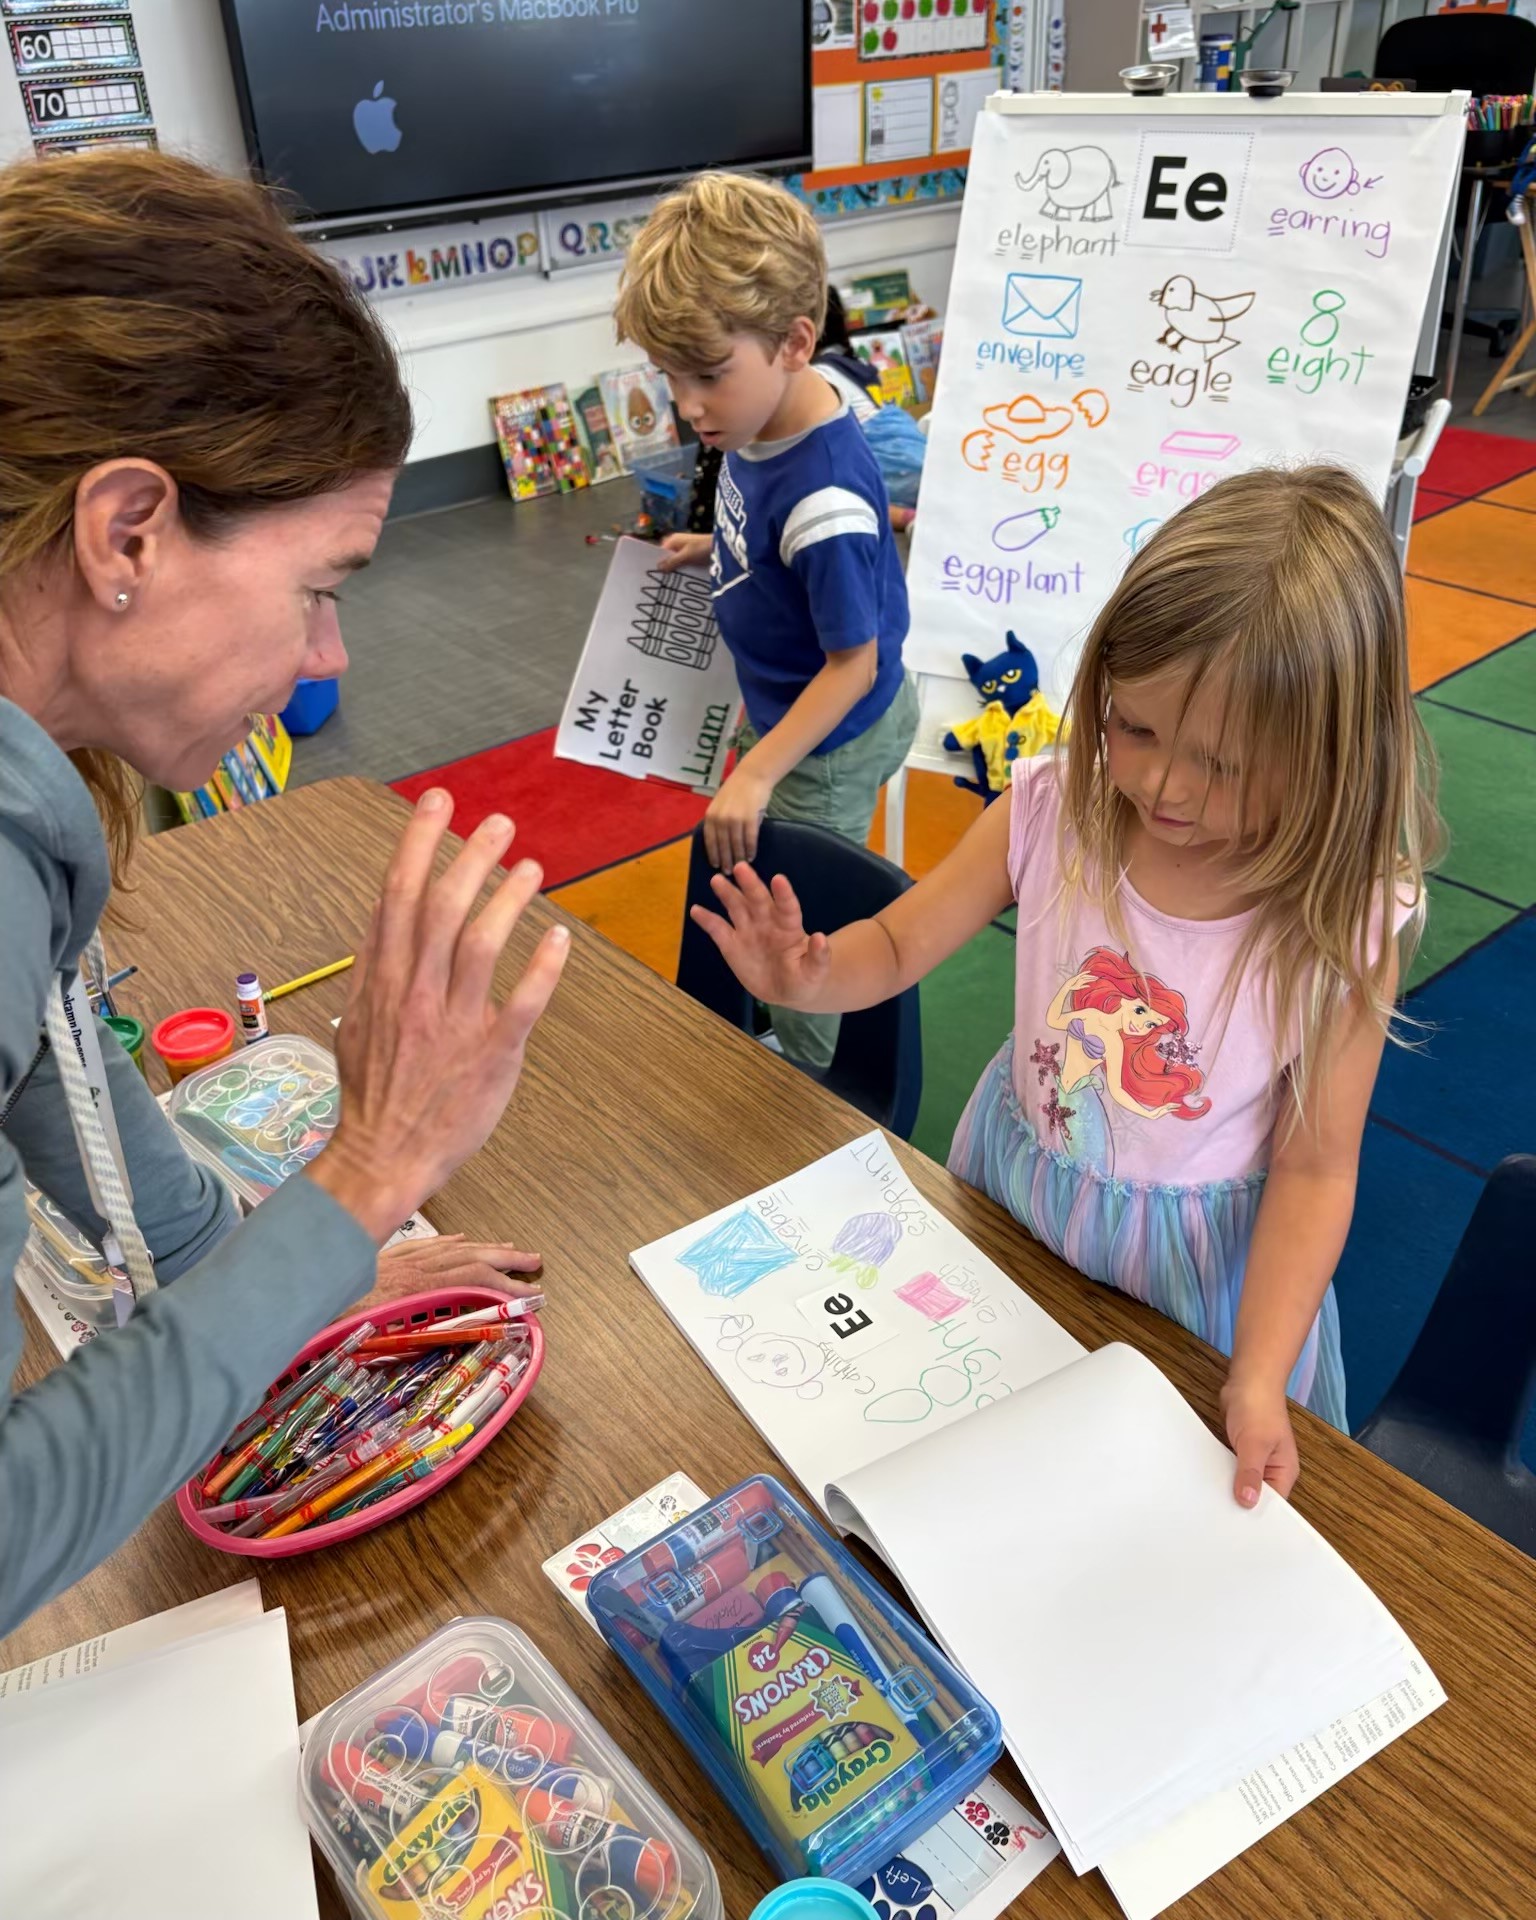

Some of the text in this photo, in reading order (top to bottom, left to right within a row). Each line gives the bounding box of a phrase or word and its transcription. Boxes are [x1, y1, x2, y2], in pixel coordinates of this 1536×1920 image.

[316, 0, 495, 32] Administrator's
[500, 0, 600, 22] MacBook
[20, 34, 52, 60] 60
[33, 92, 65, 118] 70
[1143, 156, 1228, 222] Ee
[998, 223, 1120, 263] elephant
[1269, 207, 1391, 258] earring
[977, 339, 1085, 380] envelope
[1267, 344, 1375, 395] eight
[1130, 358, 1232, 408] eagle
[1003, 450, 1070, 493] egg
[943, 554, 1086, 604] eggplant
[574, 690, 609, 732] My
[599, 679, 640, 761] Letter
[631, 697, 668, 759] Book
[680, 703, 731, 785] Liam
[823, 1291, 874, 1340] Ee
[752, 1644, 776, 1670] 24
[734, 1645, 832, 1724] CRAYONS
[780, 1725, 790, 1735] by
[788, 1709, 815, 1729] Preferred
[801, 1739, 892, 1812] Crayola
[976, 1806, 987, 1816] 2
[383, 1791, 475, 1885] Crayola
[884, 1867, 923, 1901] Left
